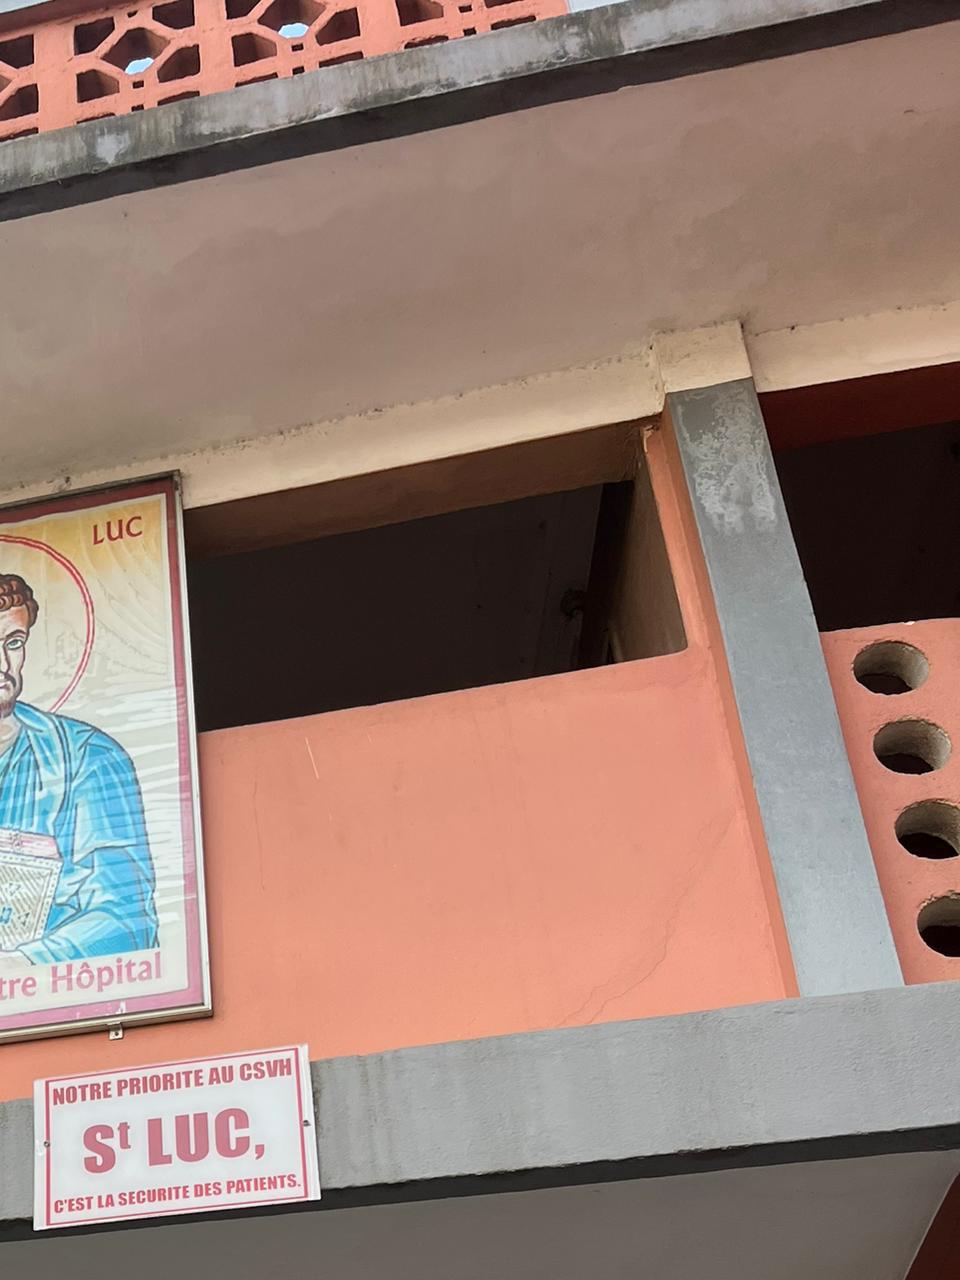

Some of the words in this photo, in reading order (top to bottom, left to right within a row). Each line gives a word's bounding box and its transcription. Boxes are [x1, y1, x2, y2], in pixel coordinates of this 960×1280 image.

[92, 516, 143, 546] LUC
[50, 951, 162, 993] Hôpital
[53, 1081, 112, 1105] NOTRE
[117, 1069, 204, 1097] PRIORITE
[208, 1065, 234, 1085] AU
[240, 1058, 292, 1081] CSVH
[83, 1121, 131, 1174] St
[147, 1108, 265, 1167] LUC,
[54, 1196, 93, 1214] C'EST
[98, 1193, 114, 1208] LA
[118, 1185, 190, 1206] SECURITE
[194, 1182, 222, 1198] DES
[226, 1173, 301, 1194] PATIENTS.
